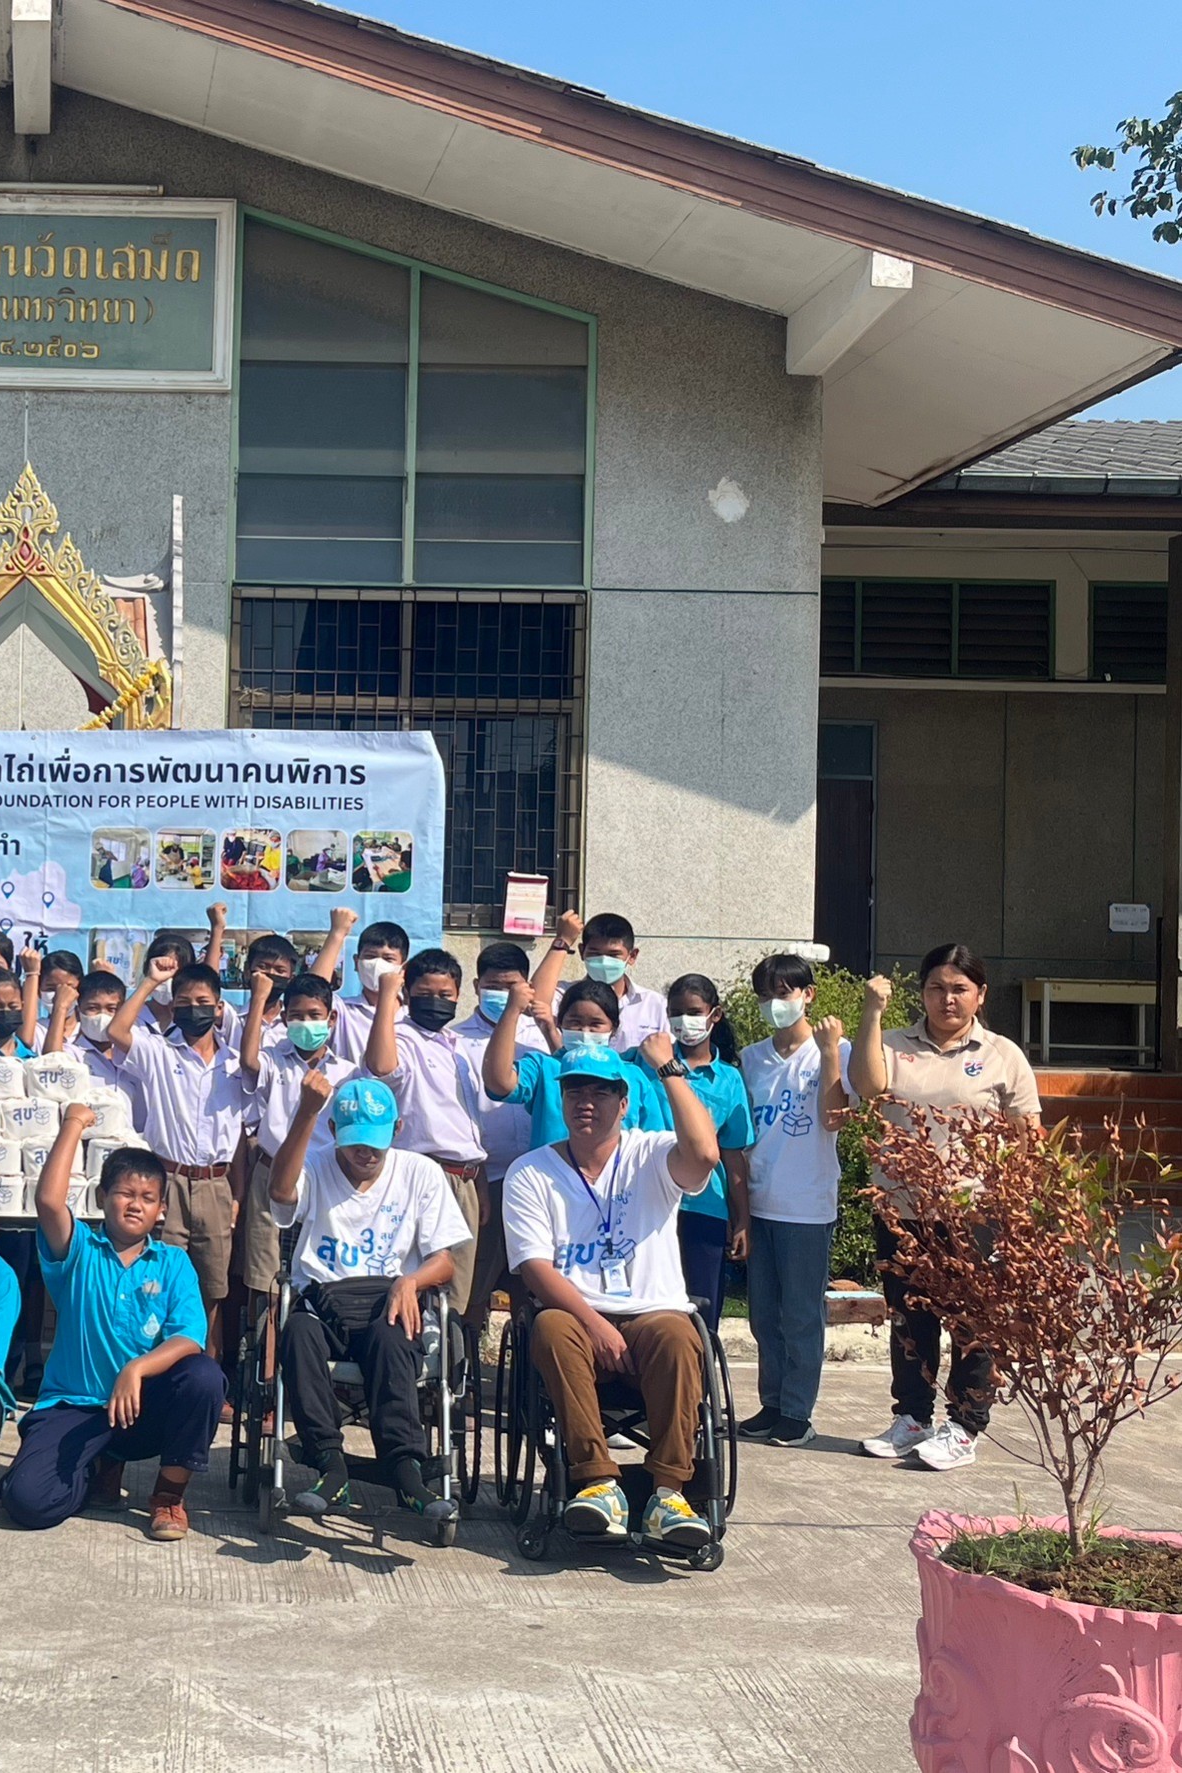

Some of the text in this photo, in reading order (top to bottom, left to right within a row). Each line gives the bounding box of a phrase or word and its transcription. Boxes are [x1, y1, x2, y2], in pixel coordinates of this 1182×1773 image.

[98, 795, 131, 809] FOR
[136, 795, 200, 809] PEOPLE
[205, 795, 248, 809] WITH
[253, 795, 364, 811] DISABILITIES
